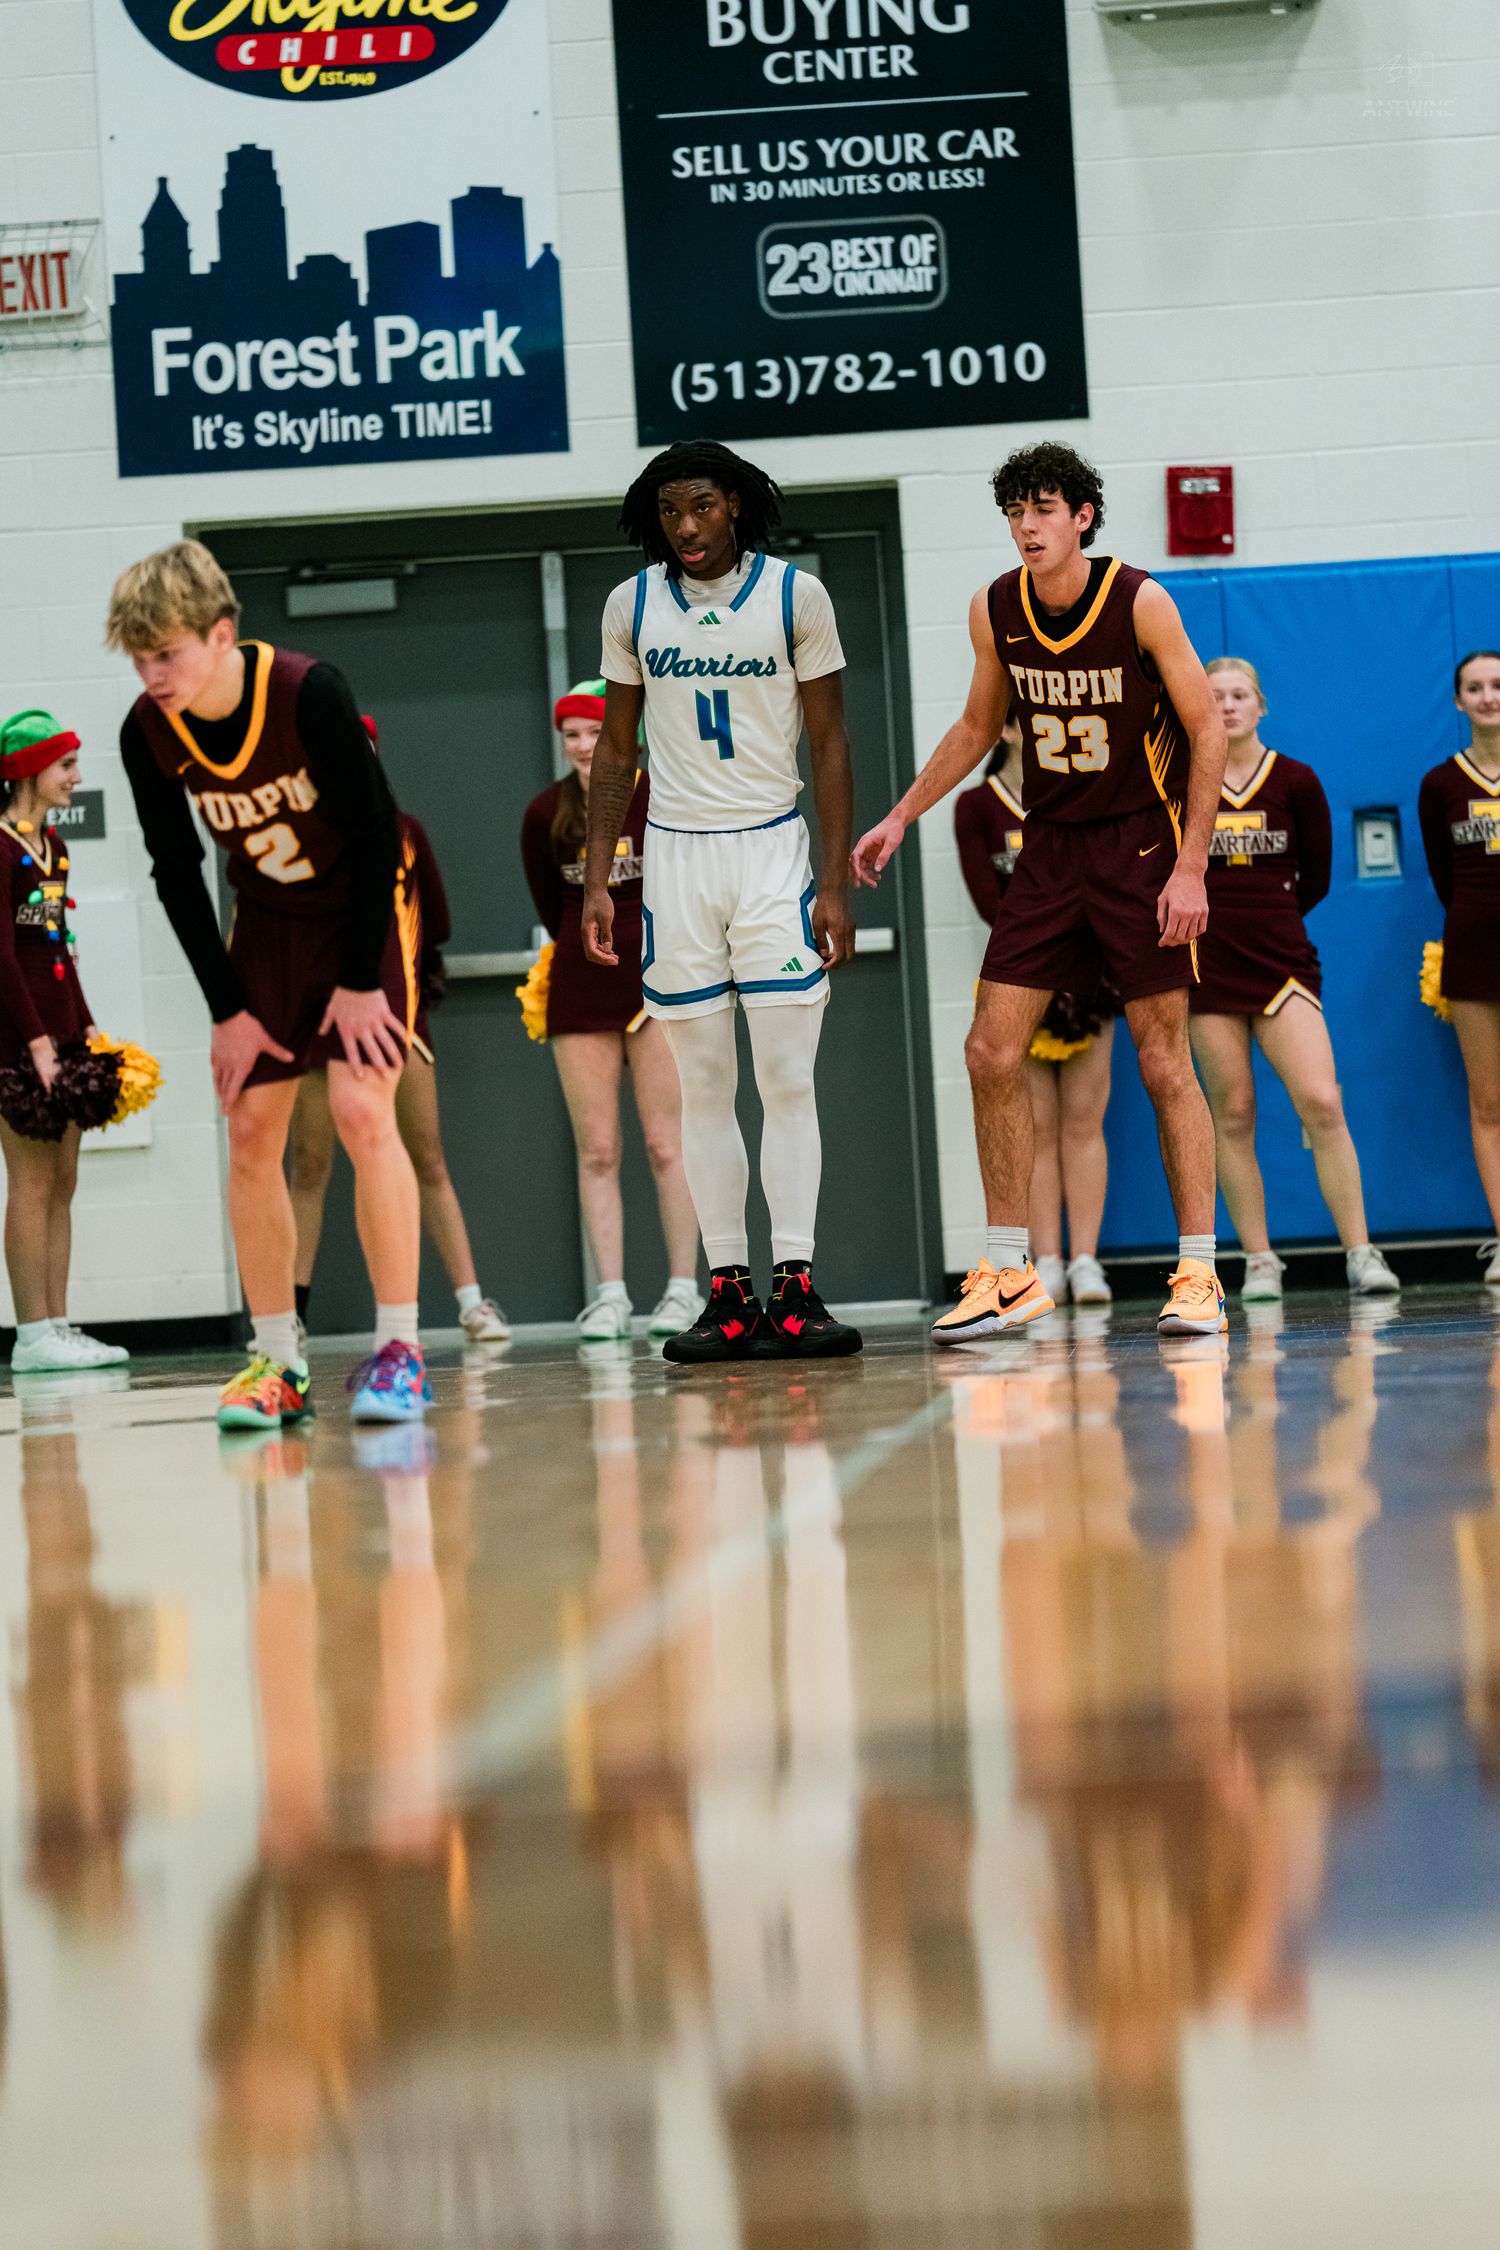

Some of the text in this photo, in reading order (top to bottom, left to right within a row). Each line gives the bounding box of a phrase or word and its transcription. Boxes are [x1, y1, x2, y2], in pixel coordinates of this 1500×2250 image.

[237, 31, 413, 65] CHILI
[707, 0, 970, 47] BUYING
[762, 45, 919, 84] CENTER
[671, 127, 1021, 178] SELL US YOUR CAR
[710, 167, 986, 203] IN 30 MINUTES OR LESS!
[765, 242, 833, 296] 23
[830, 233, 938, 271] BEST OF
[0, 251, 70, 314] EXIT
[151, 310, 526, 396] Forest Park
[671, 342, 1047, 412] (513)782-1010
[192, 399, 493, 453] It's Skyline TIME!
[645, 647, 777, 678] Warriors
[1008, 663, 1123, 706] TURPIN
[695, 688, 736, 760] 4
[1031, 713, 1110, 774] 23
[47, 805, 86, 826] EXIT
[191, 767, 319, 832] URPIN
[243, 822, 316, 884] 2
[1209, 830, 1288, 855] ARTANS
